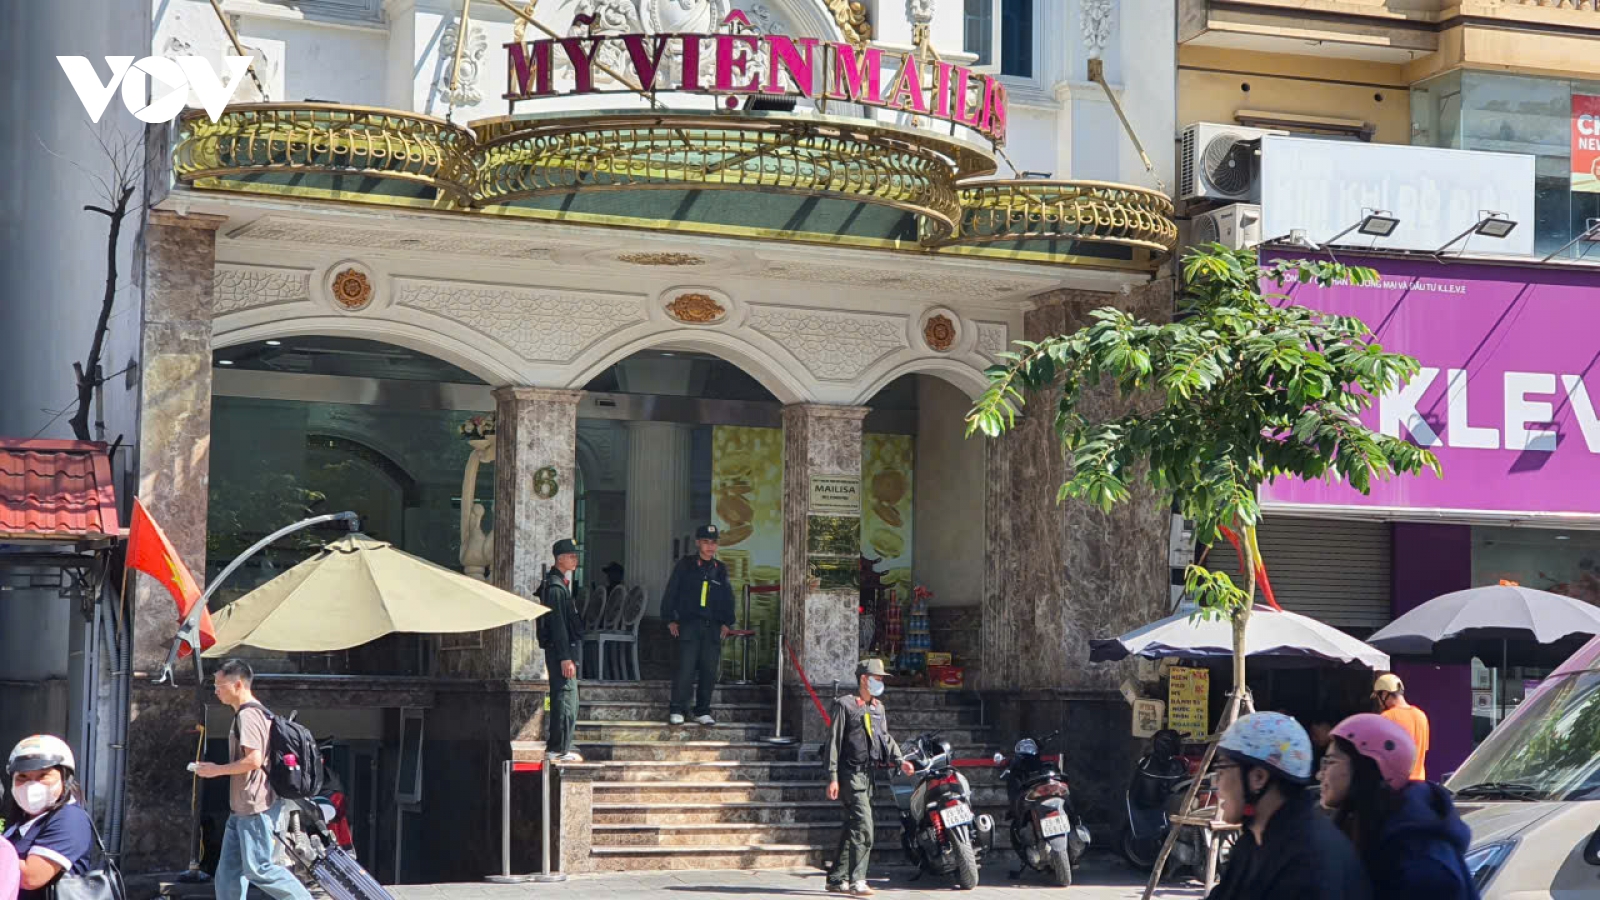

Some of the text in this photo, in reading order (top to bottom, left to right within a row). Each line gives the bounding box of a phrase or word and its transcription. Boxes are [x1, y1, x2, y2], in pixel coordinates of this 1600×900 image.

[502, 13, 606, 99] MỸ
[619, 9, 820, 108] VIỆN
[533, 467, 559, 499] 6
[814, 484, 856, 494] MAILISA
